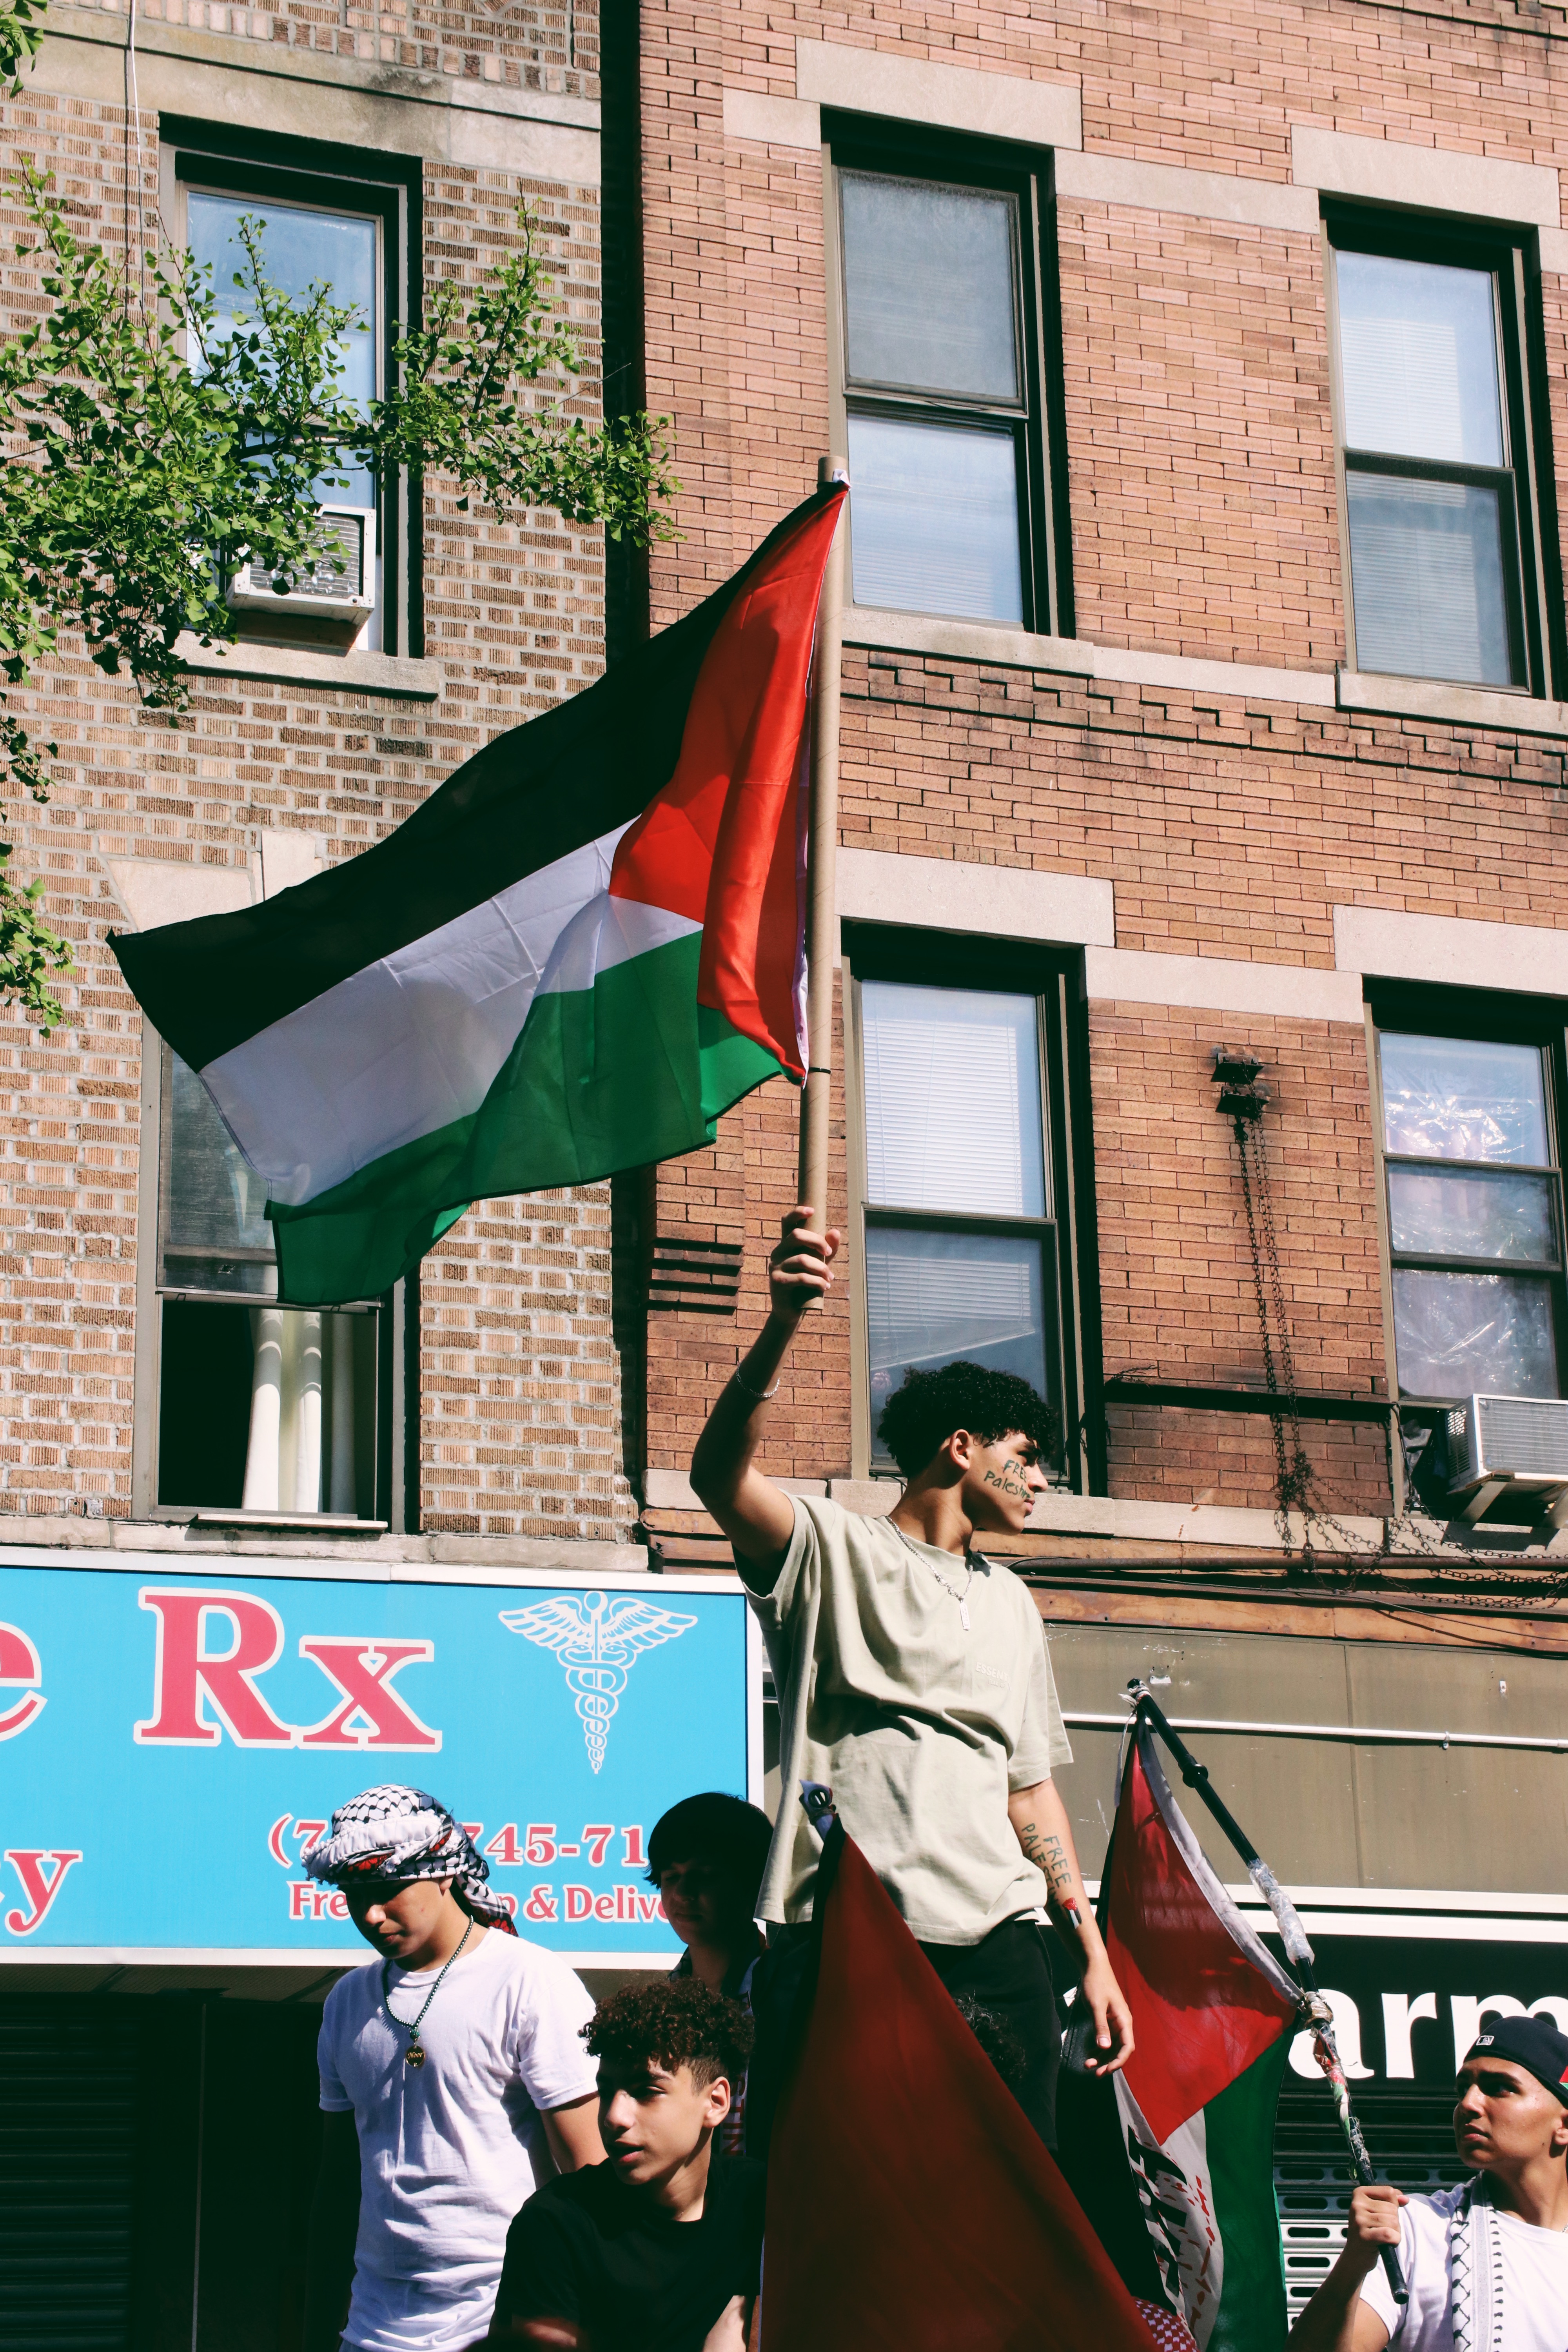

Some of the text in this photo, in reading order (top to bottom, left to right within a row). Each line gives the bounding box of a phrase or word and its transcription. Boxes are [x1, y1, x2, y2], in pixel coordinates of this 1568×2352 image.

[134, 1586, 443, 1753] Rx
[1043, 1835, 1071, 1887] FREE
[0, 1849, 83, 1936] y
[523, 1884, 559, 1922] &
[407, 2051, 423, 2059] Noor
